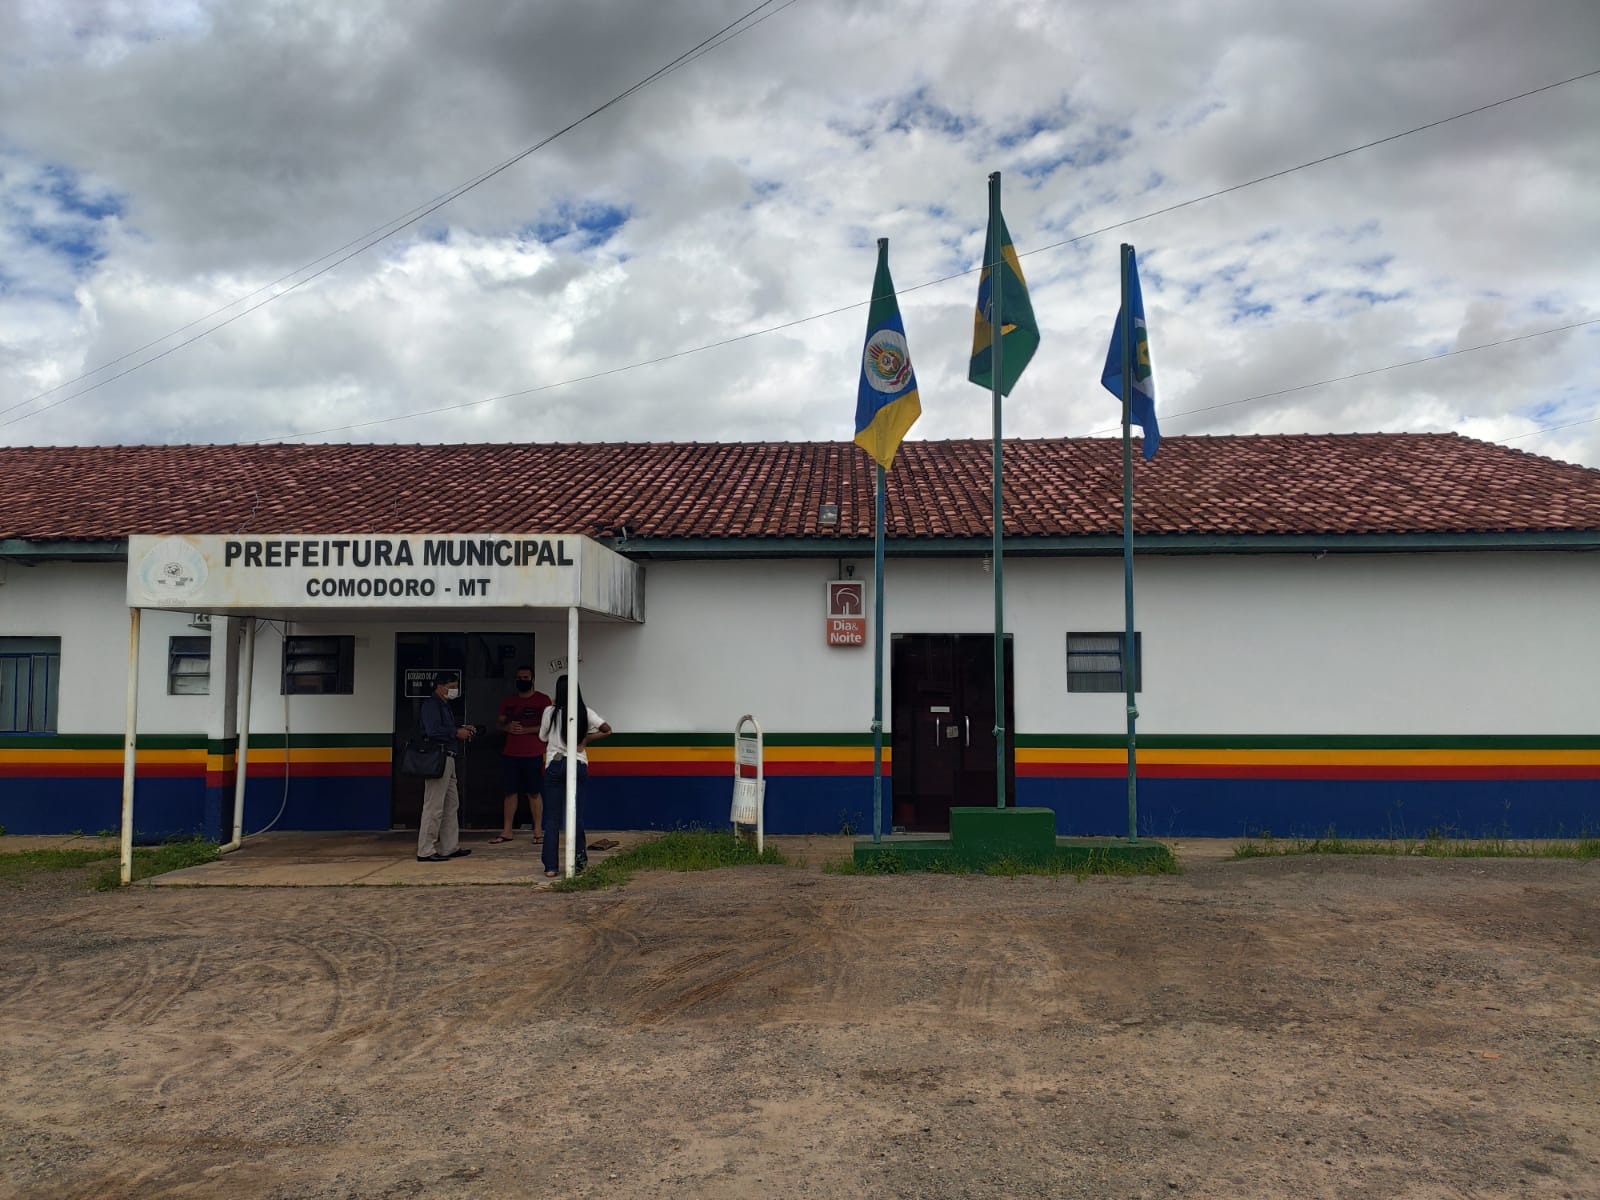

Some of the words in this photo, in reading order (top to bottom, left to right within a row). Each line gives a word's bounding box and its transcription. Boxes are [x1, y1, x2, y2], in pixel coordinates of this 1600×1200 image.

[225, 540, 414, 567] PREFEITURA
[424, 539, 574, 566] MUNICIPAL
[306, 578, 436, 597] COMODORO
[458, 578, 491, 597] MT
[830, 632, 862, 643] Noite
